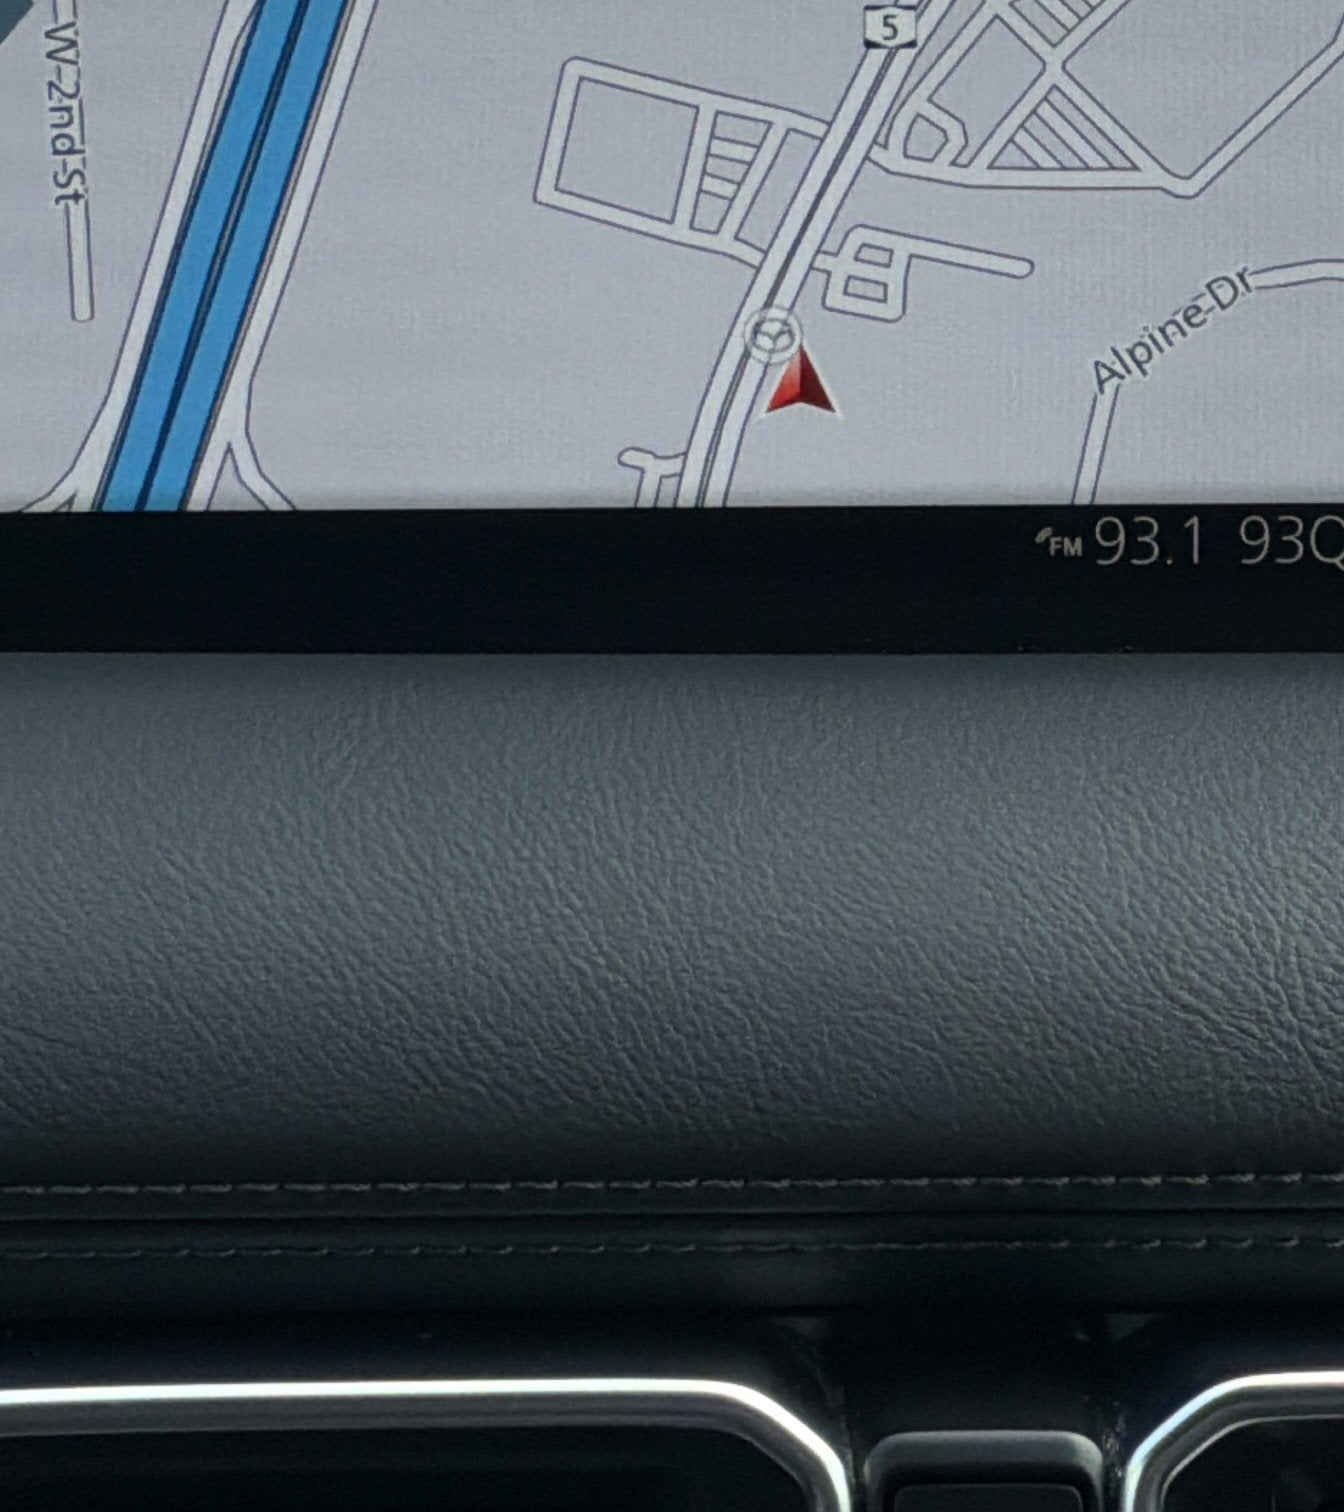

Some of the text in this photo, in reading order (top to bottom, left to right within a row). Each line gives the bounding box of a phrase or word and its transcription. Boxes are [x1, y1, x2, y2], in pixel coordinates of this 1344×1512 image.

[881, 13, 899, 41] 5
[43, 21, 86, 205] W 2nd St
[1094, 266, 1253, 396] Alpine Dr
[1049, 536, 1083, 558] FM
[1094, 515, 1201, 565] 93.1
